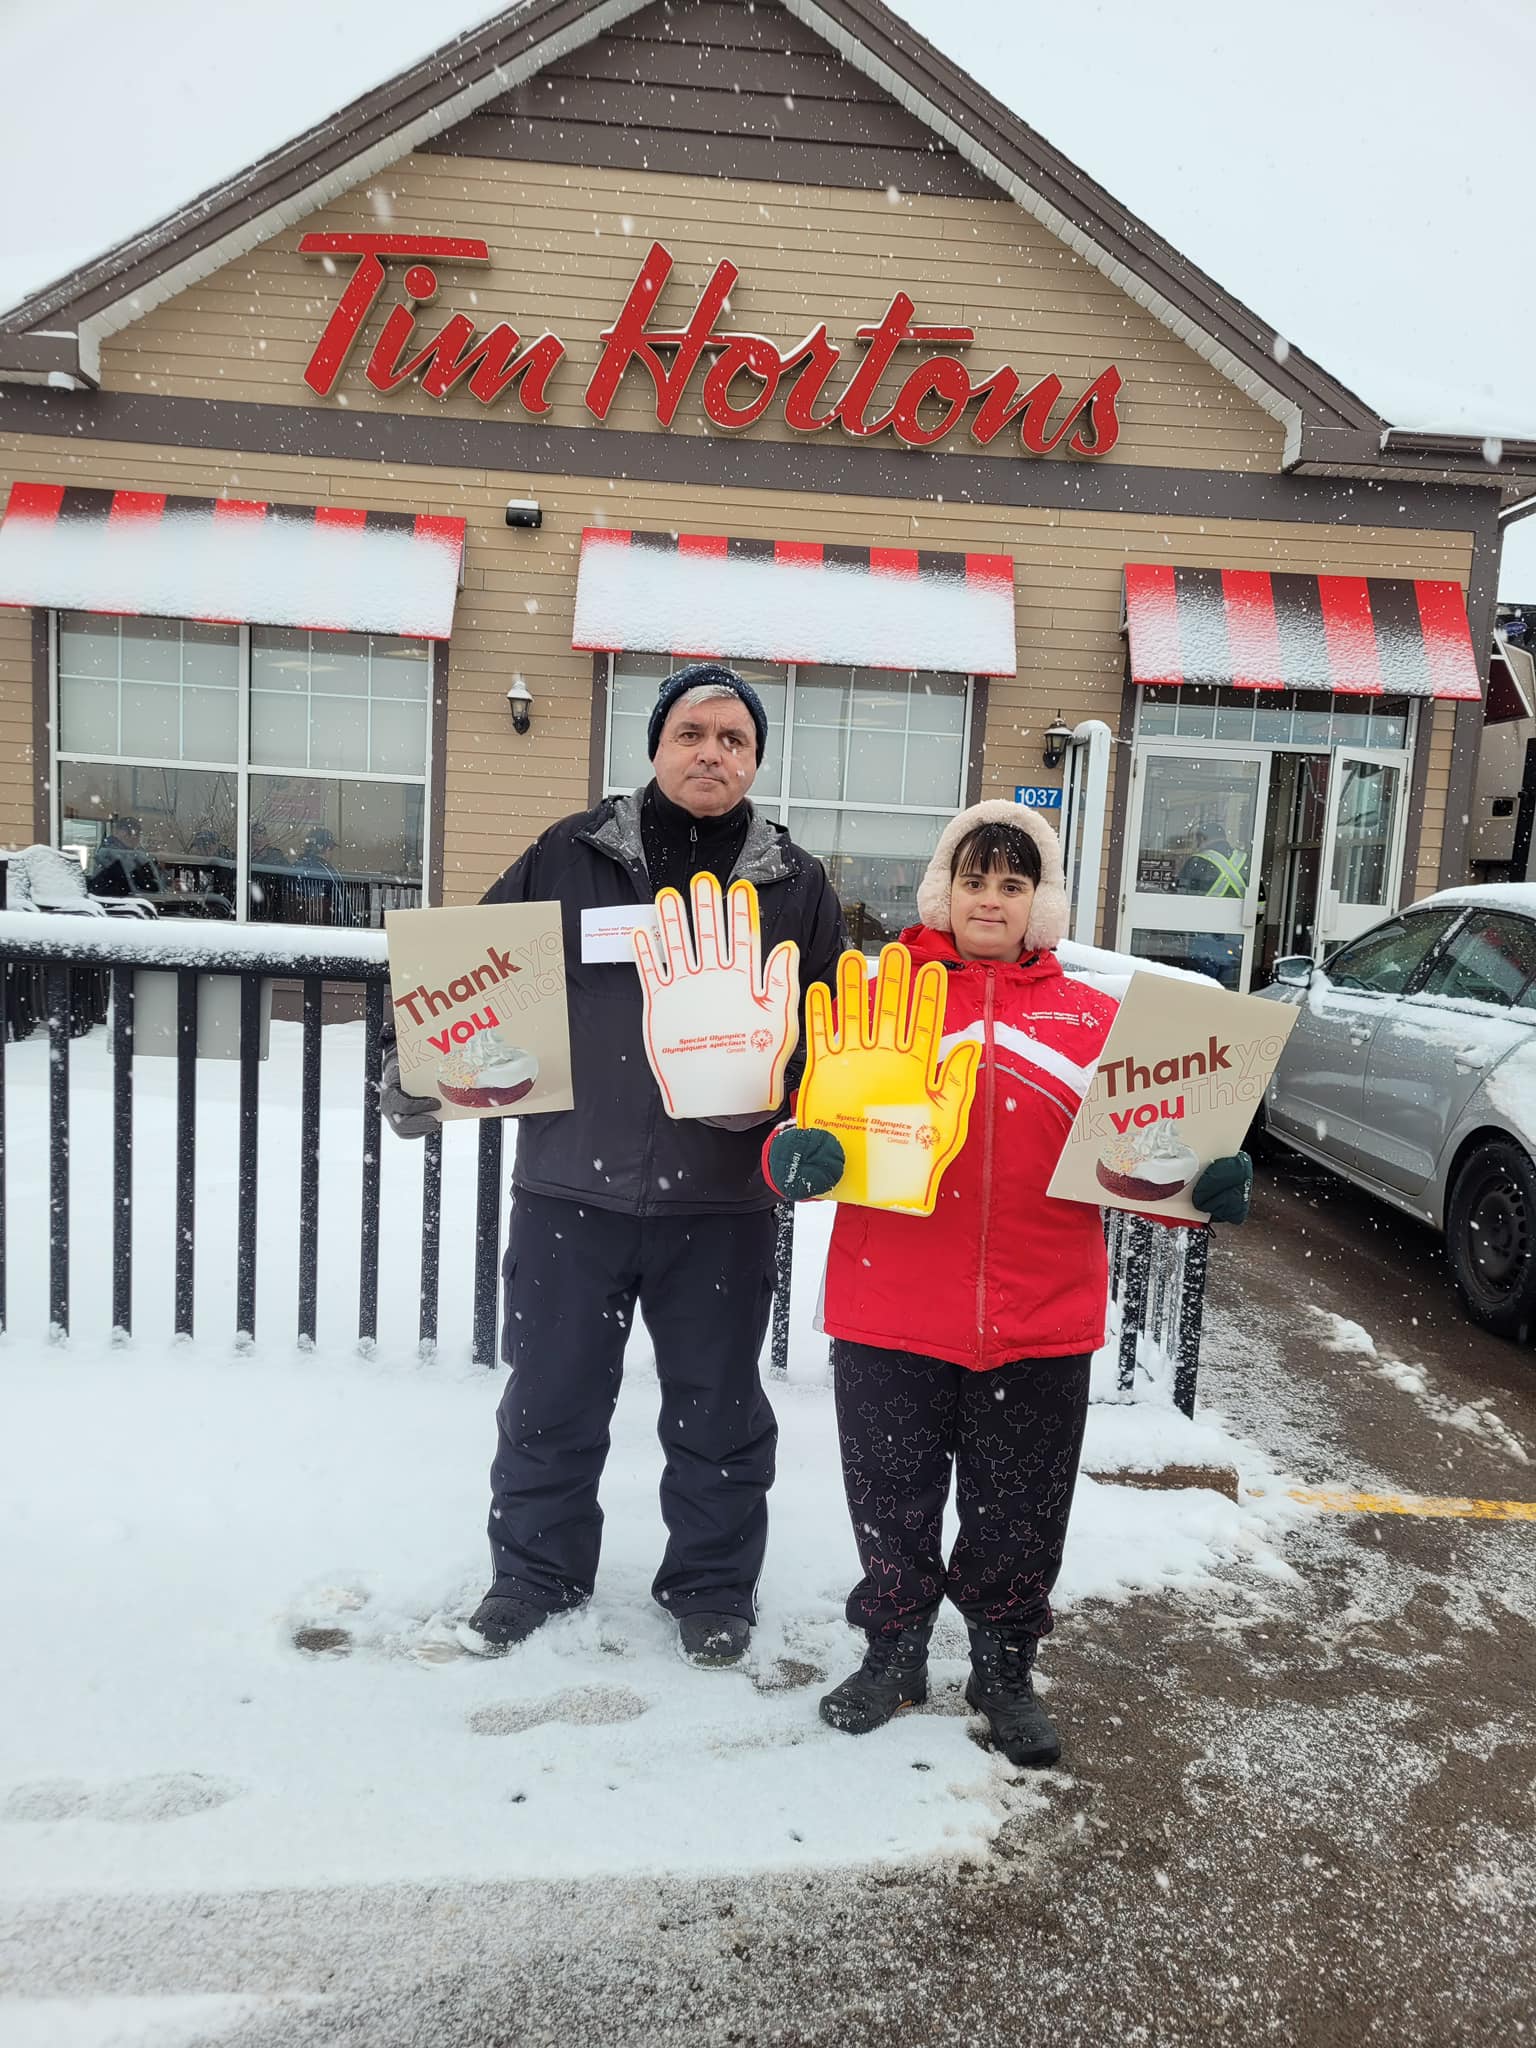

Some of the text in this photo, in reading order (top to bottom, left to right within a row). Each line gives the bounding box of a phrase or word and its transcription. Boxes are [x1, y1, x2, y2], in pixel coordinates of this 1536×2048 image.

[298, 233, 1122, 456] Tim Hortons
[1018, 788, 1058, 806] 1037
[394, 947, 522, 1026] Thank
[427, 1005, 500, 1055] you
[679, 1033, 746, 1045] Special Olympics
[662, 1043, 708, 1054] Olympiques
[1097, 1036, 1232, 1098] Thank
[814, 1118, 867, 1131] Olympiques
[836, 1113, 912, 1130] Special Olympics
[1109, 1096, 1185, 1135] you
